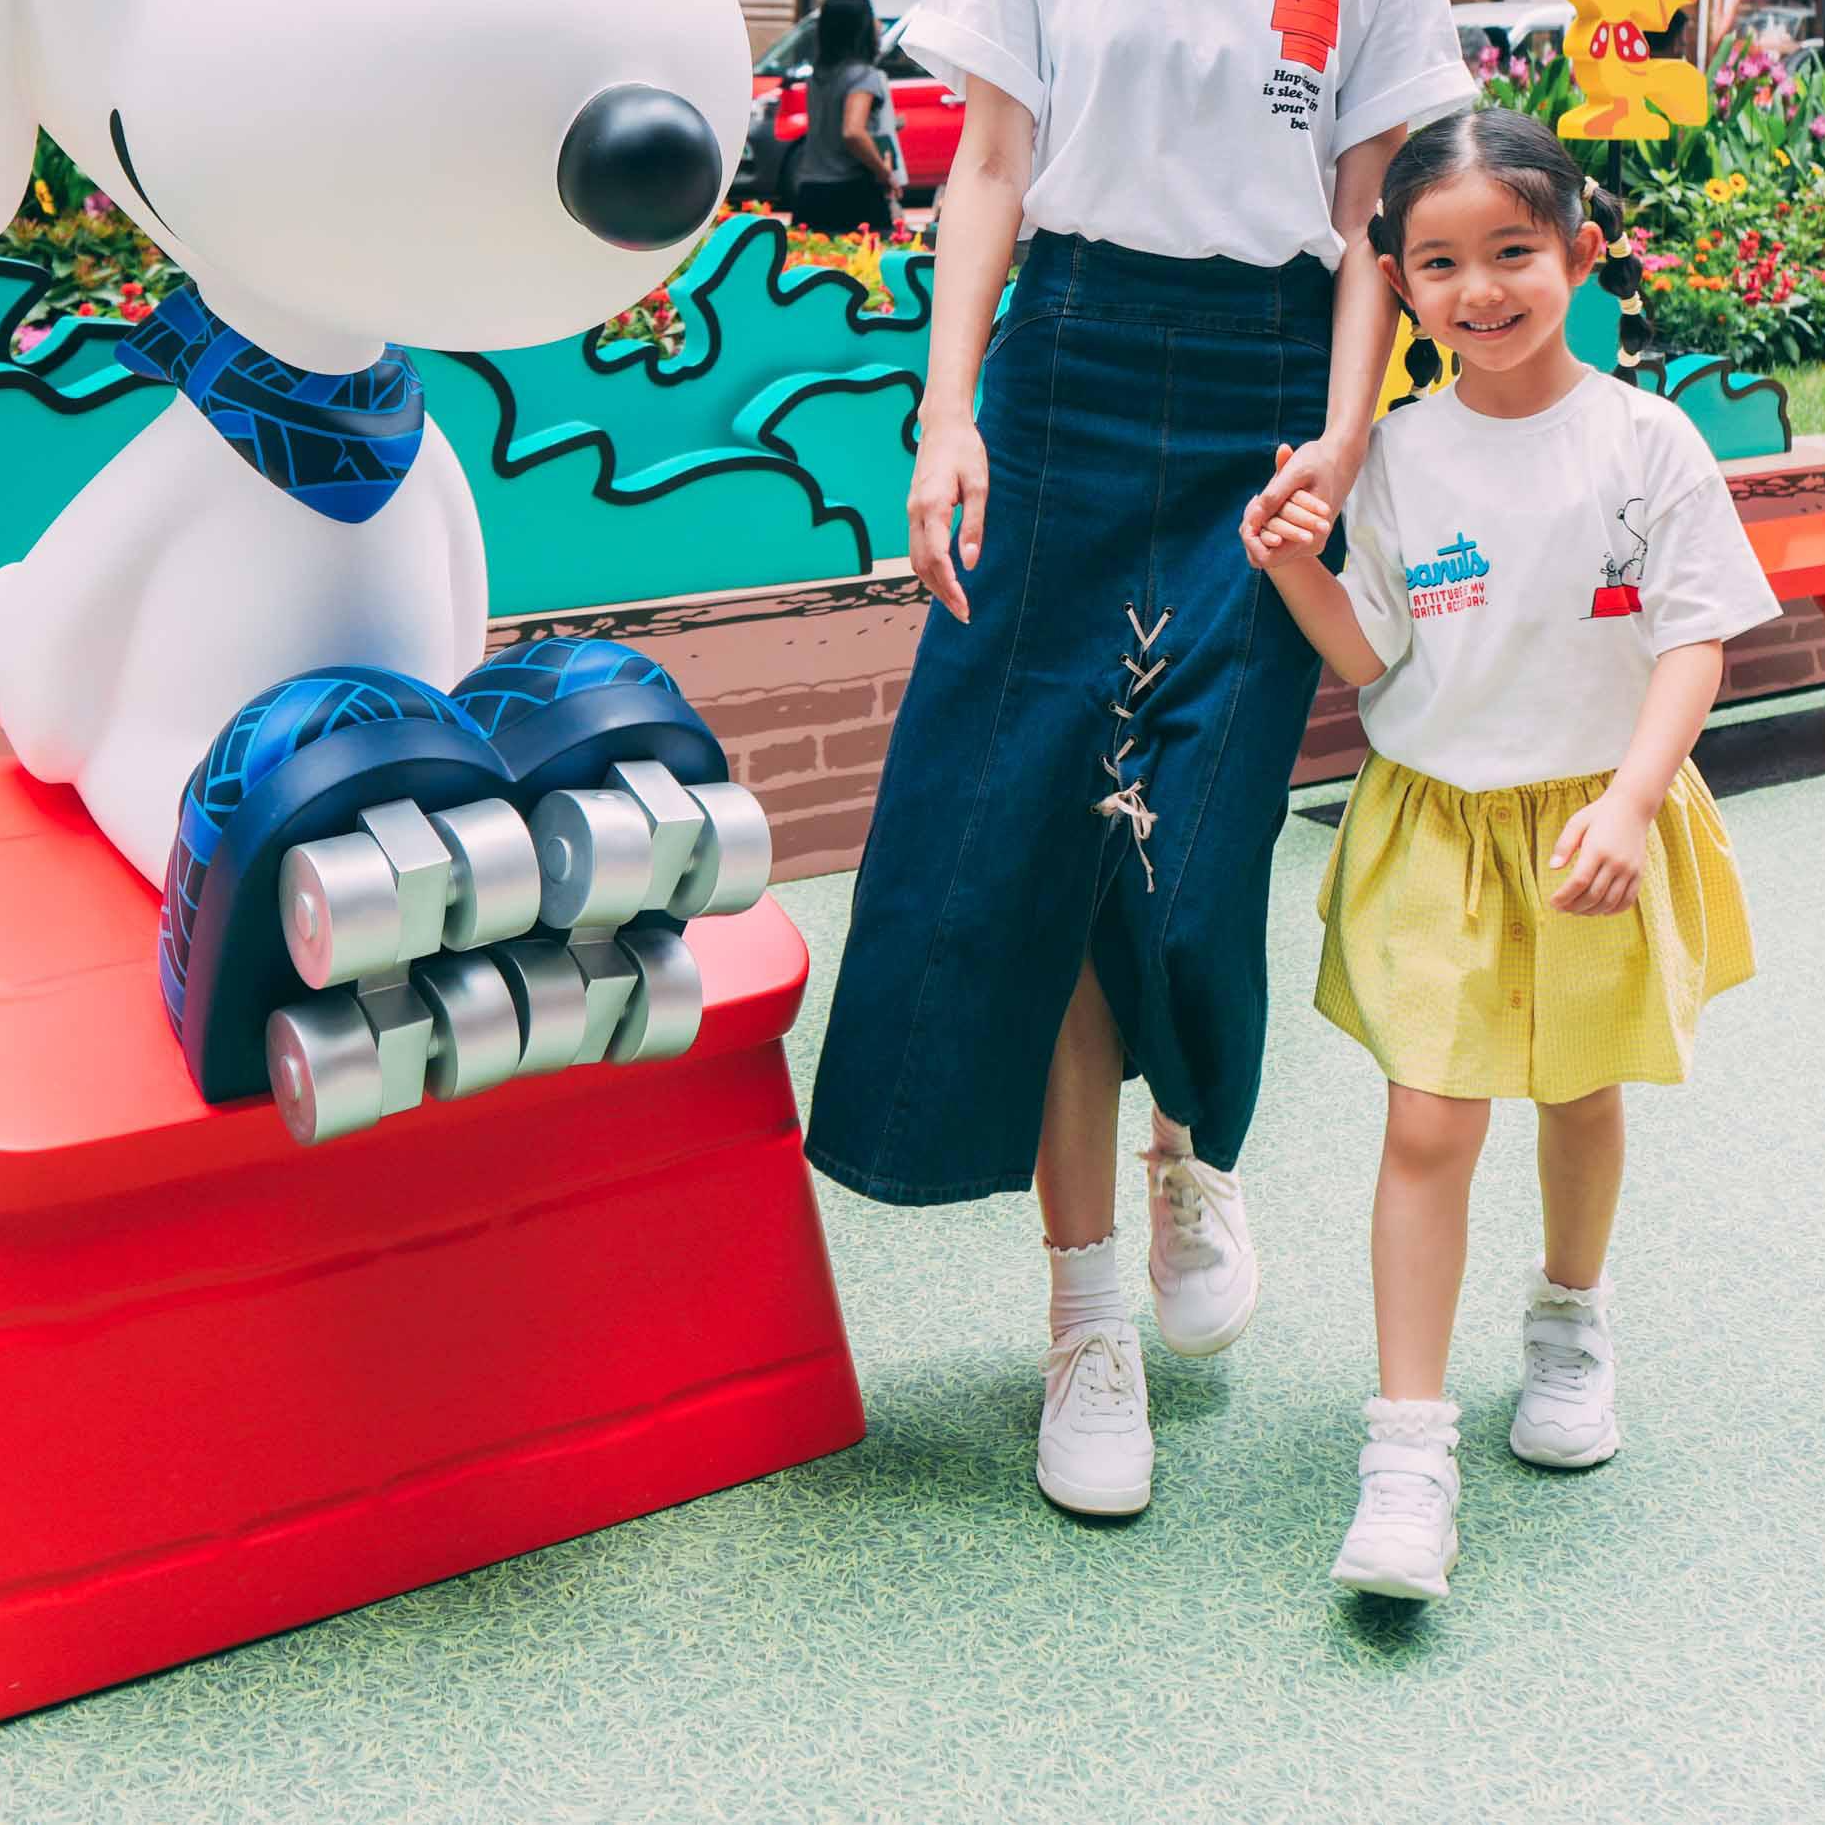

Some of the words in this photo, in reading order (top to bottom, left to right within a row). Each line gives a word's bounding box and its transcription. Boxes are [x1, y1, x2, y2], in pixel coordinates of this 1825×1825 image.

[1263, 83, 1275, 96] is
[1271, 102, 1306, 115] your
[1471, 581, 1485, 595] MY
